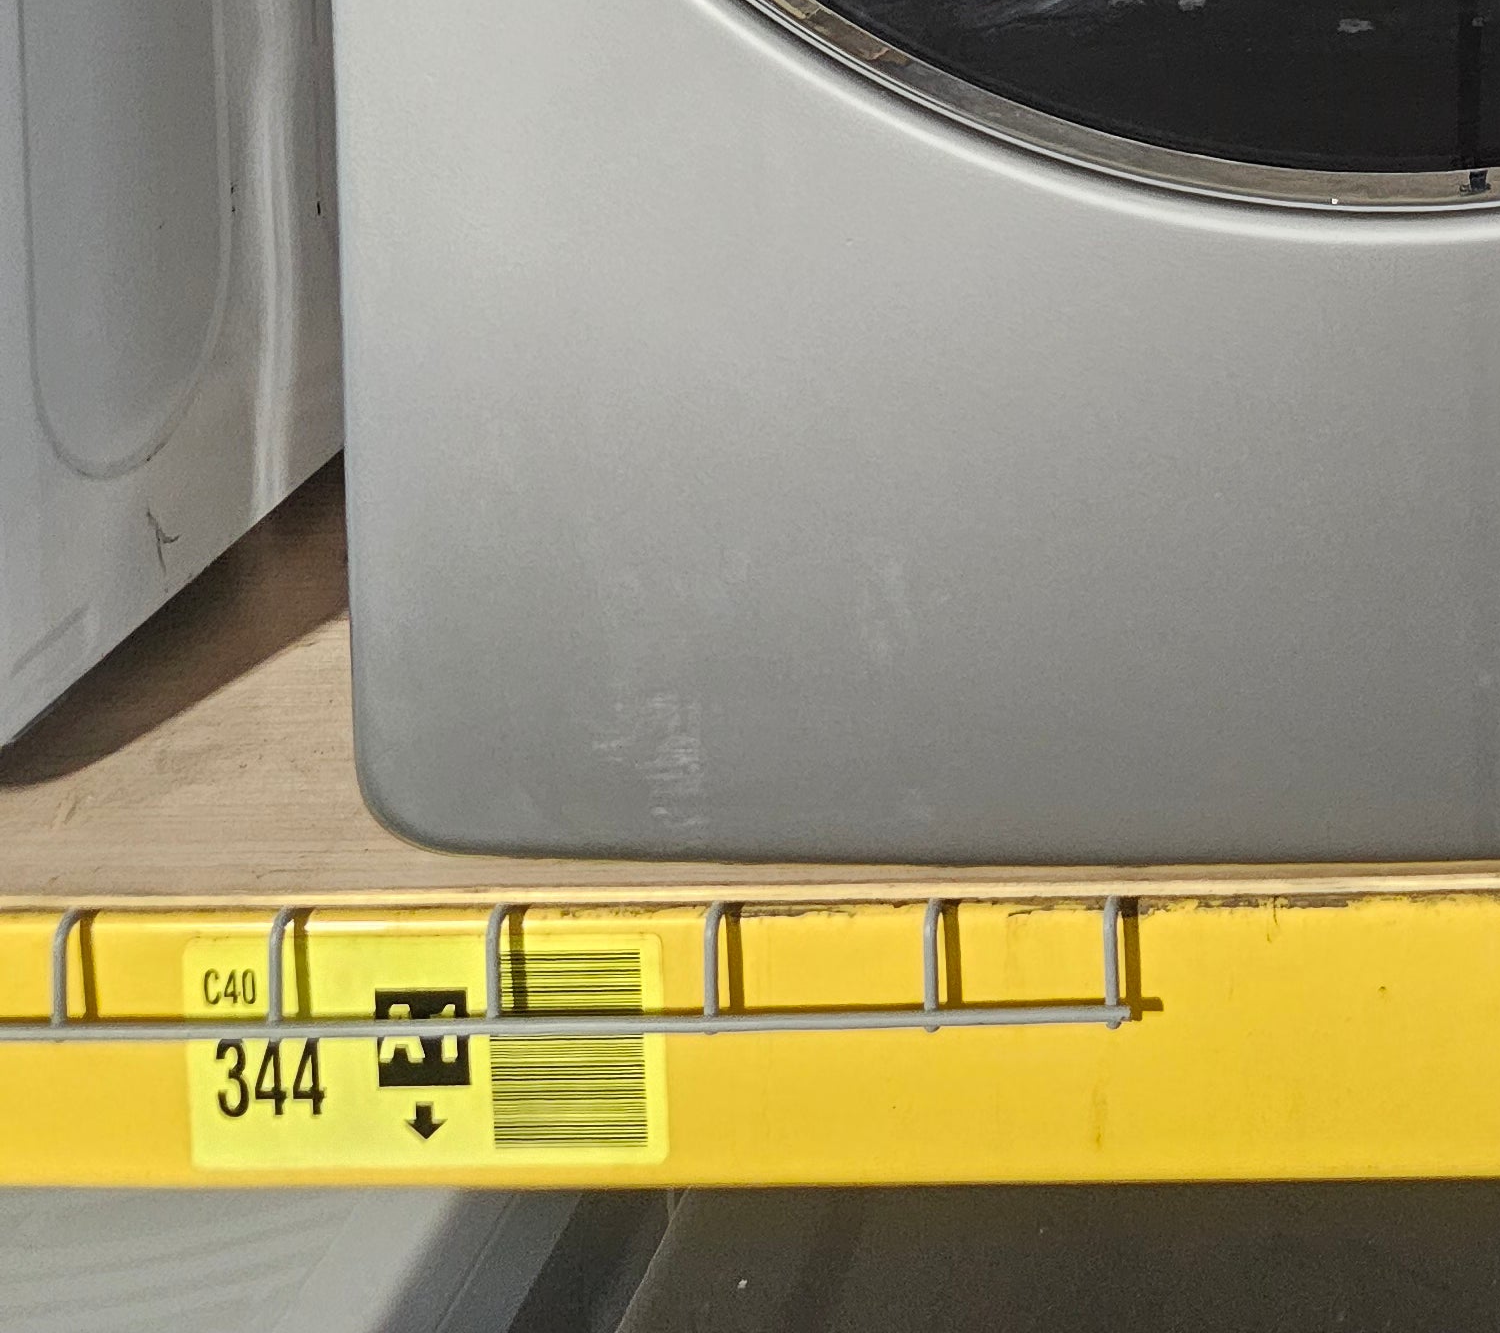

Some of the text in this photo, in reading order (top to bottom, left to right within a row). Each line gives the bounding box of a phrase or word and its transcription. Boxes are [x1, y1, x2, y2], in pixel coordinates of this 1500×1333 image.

[204, 968, 257, 1005] C40
[379, 1004, 458, 1063] A1
[216, 1037, 326, 1118] 344
